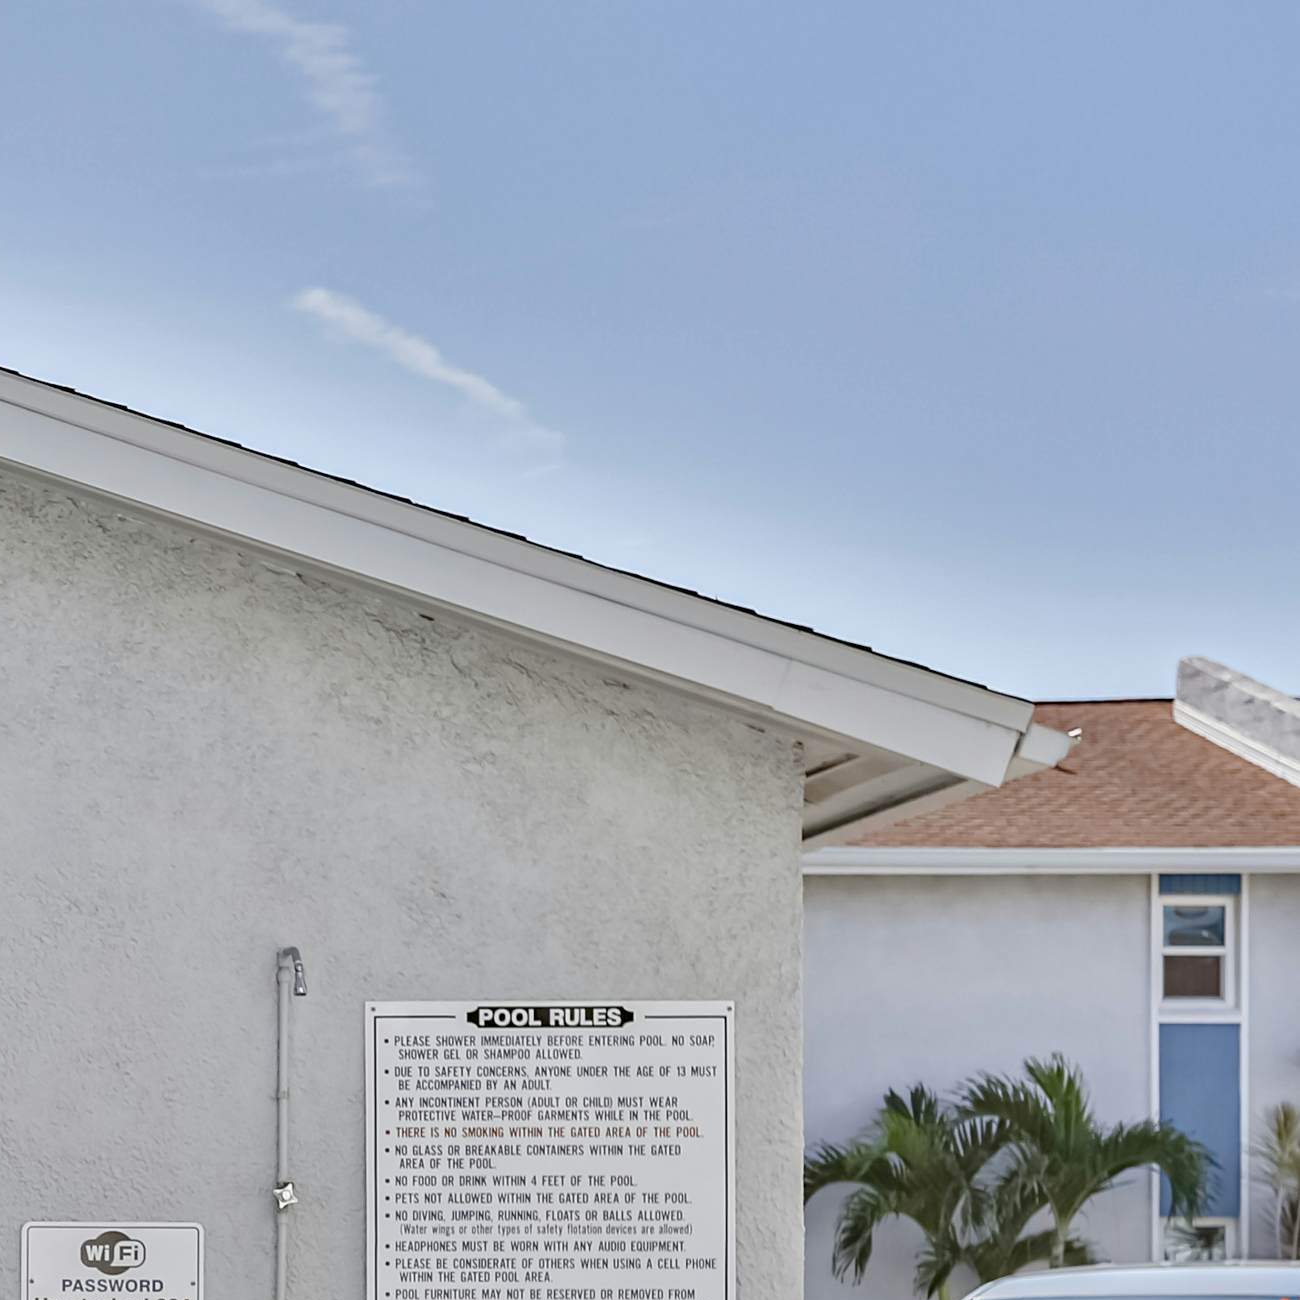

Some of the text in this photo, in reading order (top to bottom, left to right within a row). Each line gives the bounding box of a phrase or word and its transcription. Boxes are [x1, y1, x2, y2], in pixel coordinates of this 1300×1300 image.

[478, 1008, 622, 1027] POOL RULES
[394, 1035, 431, 1047] PLEASE
[435, 1035, 476, 1047] SHOWER
[480, 1035, 542, 1047] IMMEDIATELY
[547, 1035, 584, 1047] BEFORE
[588, 1035, 635, 1047] ENTERING
[671, 1035, 685, 1047] NO
[398, 1049, 439, 1060] SHOWER
[443, 1049, 461, 1060] GEL
[466, 1049, 479, 1060] OR
[484, 1049, 531, 1060] SHAMPOO
[394, 1066, 413, 1077] DUE
[417, 1066, 430, 1077] TO
[435, 1066, 472, 1077] SAFETY
[534, 1066, 572, 1077] ANYONE
[576, 1066, 608, 1077] UNDER
[613, 1066, 631, 1077] THE
[636, 1066, 654, 1077] AGE
[659, 1066, 671, 1077] OF
[676, 1066, 686, 1077] 13
[691, 1066, 717, 1077] MUST
[398, 1079, 411, 1091] BE
[415, 1079, 482, 1091] ACCOMPANIED
[486, 1079, 498, 1091] BY
[503, 1079, 517, 1091] AN
[396, 1127, 426, 1138] THERE
[430, 1127, 440, 1138] IS
[444, 1127, 457, 1138] NO
[461, 1127, 504, 1138] SMOKING
[509, 1127, 543, 1138] WITHIN
[548, 1127, 565, 1138] THE
[570, 1127, 601, 1138] GATED
[605, 1127, 631, 1138] AREA
[636, 1127, 648, 1138] OF
[653, 1127, 671, 1138] THE
[395, 1175, 408, 1187] NO
[412, 1175, 437, 1187] FOOD
[441, 1175, 454, 1187] OR
[459, 1175, 487, 1187] DRINK
[492, 1175, 526, 1187] WITHIN
[531, 1175, 537, 1186] 4
[542, 1175, 565, 1187] FEET
[570, 1175, 582, 1187] OF
[588, 1175, 606, 1187] THE
[395, 1210, 408, 1221] NO
[545, 1210, 580, 1221] FLOATS
[585, 1210, 598, 1221] OR
[602, 1210, 633, 1221] BALLS
[400, 1224, 693, 1236] (Water wings or other types of safety flotation devices are allowed)
[395, 1241, 457, 1252] HEADPHONES
[462, 1241, 488, 1252] MUST
[493, 1241, 505, 1252] BE
[510, 1241, 539, 1252] WORN
[543, 1241, 569, 1252] WITH
[573, 1241, 593, 1252] ANY
[598, 1241, 626, 1252] AUDIO
[61, 1279, 164, 1293] PASSWORD
